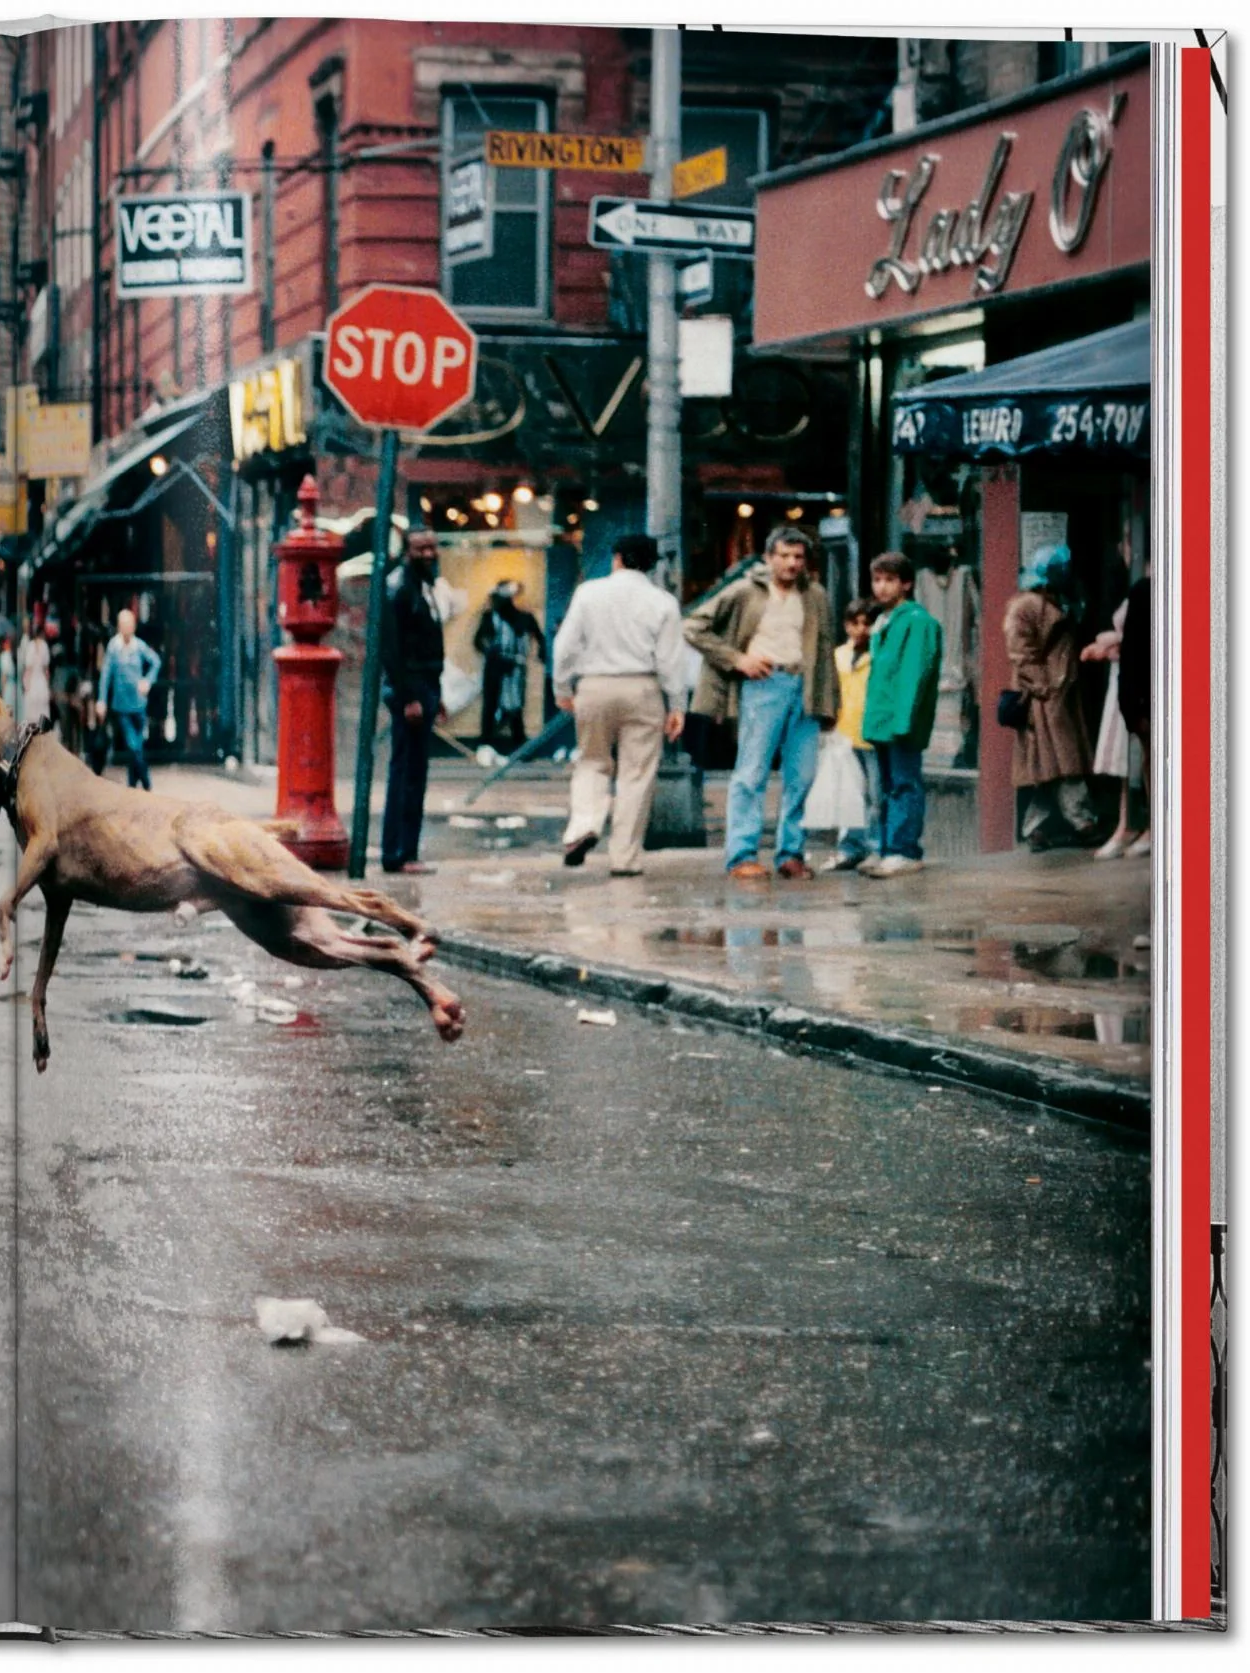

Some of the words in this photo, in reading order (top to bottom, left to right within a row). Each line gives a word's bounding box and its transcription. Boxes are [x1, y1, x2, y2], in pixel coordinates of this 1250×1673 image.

[490, 133, 625, 166] RIVINGTON
[616, 213, 656, 233] ONE
[694, 219, 742, 241] WAY
[864, 131, 1034, 299] Lady
[333, 325, 466, 389] STOP
